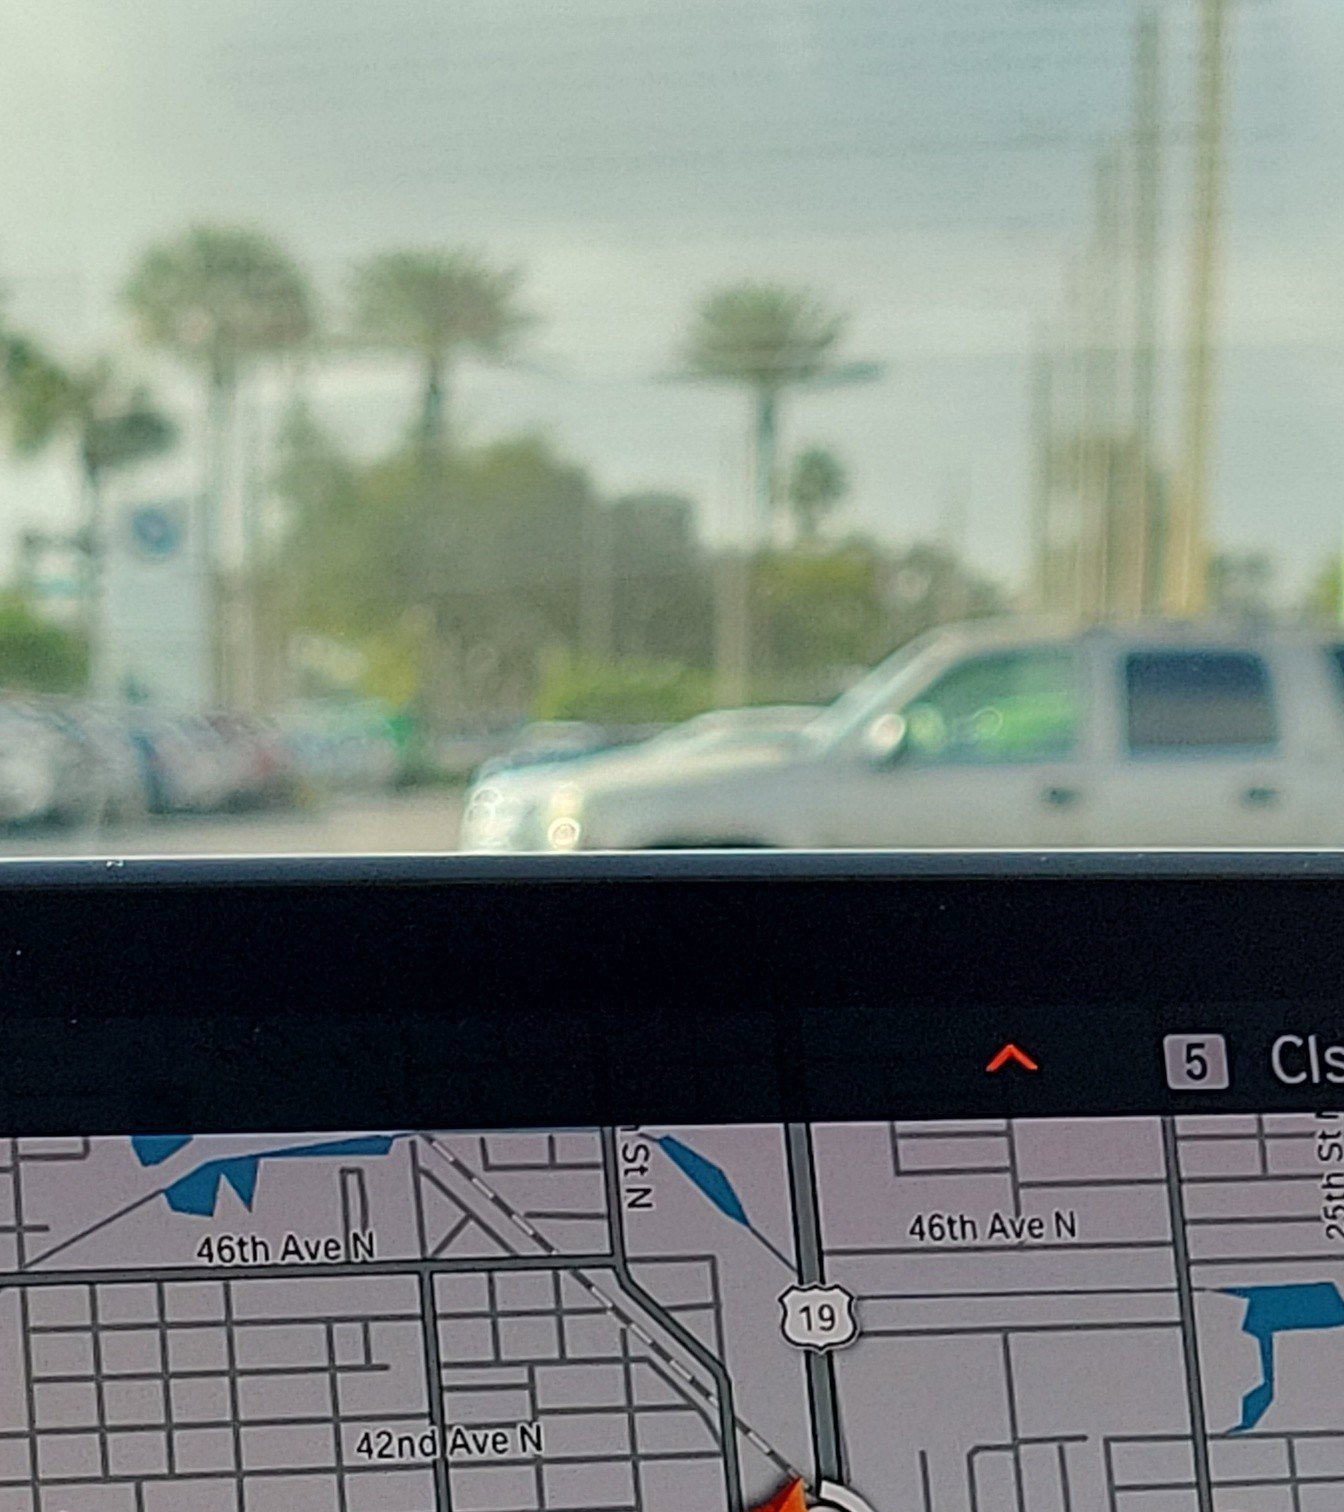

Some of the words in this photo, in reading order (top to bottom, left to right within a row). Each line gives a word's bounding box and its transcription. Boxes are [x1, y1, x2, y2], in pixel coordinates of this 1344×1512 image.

[1185, 1044, 1209, 1081] 5
[622, 1143, 650, 1176] St
[1318, 1130, 1343, 1162] St
[625, 1188, 653, 1208] N
[908, 1212, 979, 1242] 46th
[987, 1212, 1049, 1241] Ave
[1056, 1211, 1077, 1238] N
[196, 1234, 269, 1263] 46th
[278, 1236, 344, 1262] Ave
[353, 1233, 375, 1260] N
[800, 1302, 835, 1332] 19
[356, 1431, 437, 1460] 42nd
[449, 1428, 511, 1456] Ave
[519, 1425, 543, 1453] N
